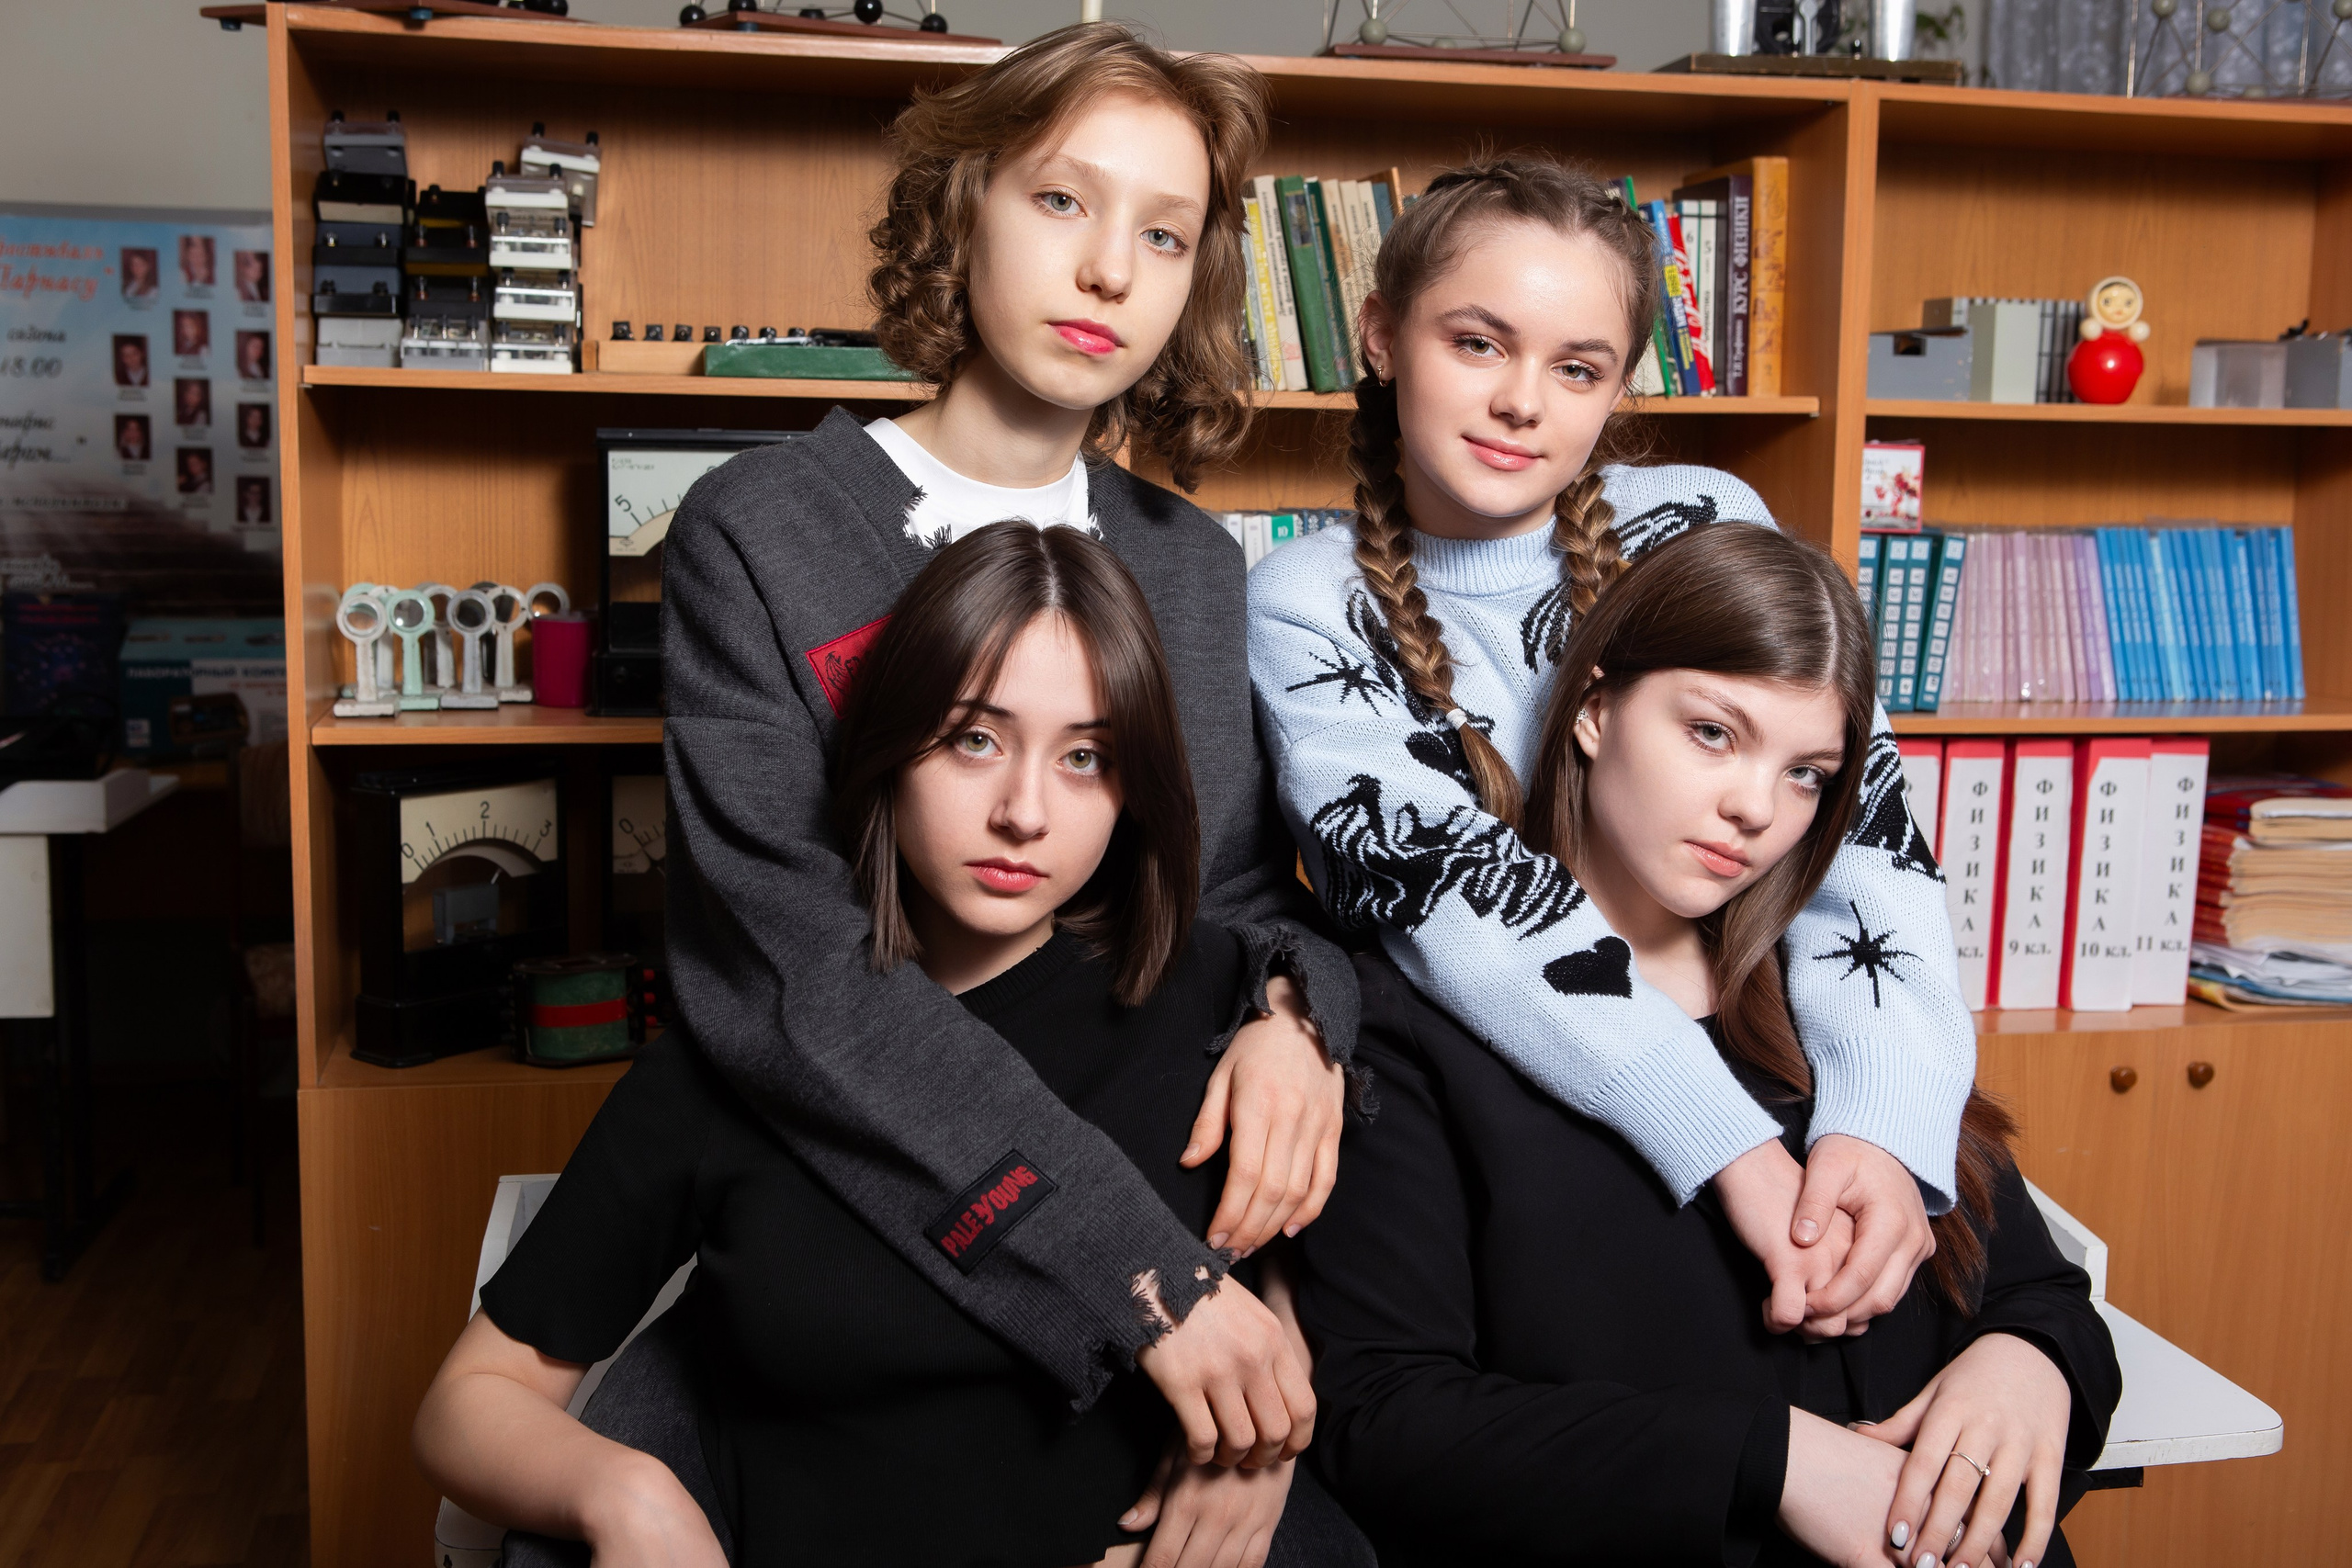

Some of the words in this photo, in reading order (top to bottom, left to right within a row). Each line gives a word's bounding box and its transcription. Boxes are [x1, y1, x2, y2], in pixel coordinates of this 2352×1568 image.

[1732, 197, 1750, 267] ФИЗИКИ
[1732, 271, 1748, 314] КУРС
[615, 494, 632, 513] 5
[1278, 525, 1288, 537] 10
[401, 841, 415, 860] 0
[425, 822, 435, 836] 1
[480, 801, 491, 819] 2
[539, 819, 553, 838] 3
[618, 818, 634, 835] 0
[1962, 781, 1988, 932] ФИЗИКА
[2029, 779, 2053, 929] ФИЗИКА
[2092, 781, 2117, 931] ФИЗИКА
[2164, 776, 2194, 926] ФИЗИКА
[2009, 940, 2018, 955] 9
[2025, 942, 2052, 955] кл.
[2081, 942, 2099, 957] 10
[2105, 945, 2132, 958] кл.
[2136, 936, 2154, 951] 11
[2160, 940, 2188, 952] кл.
